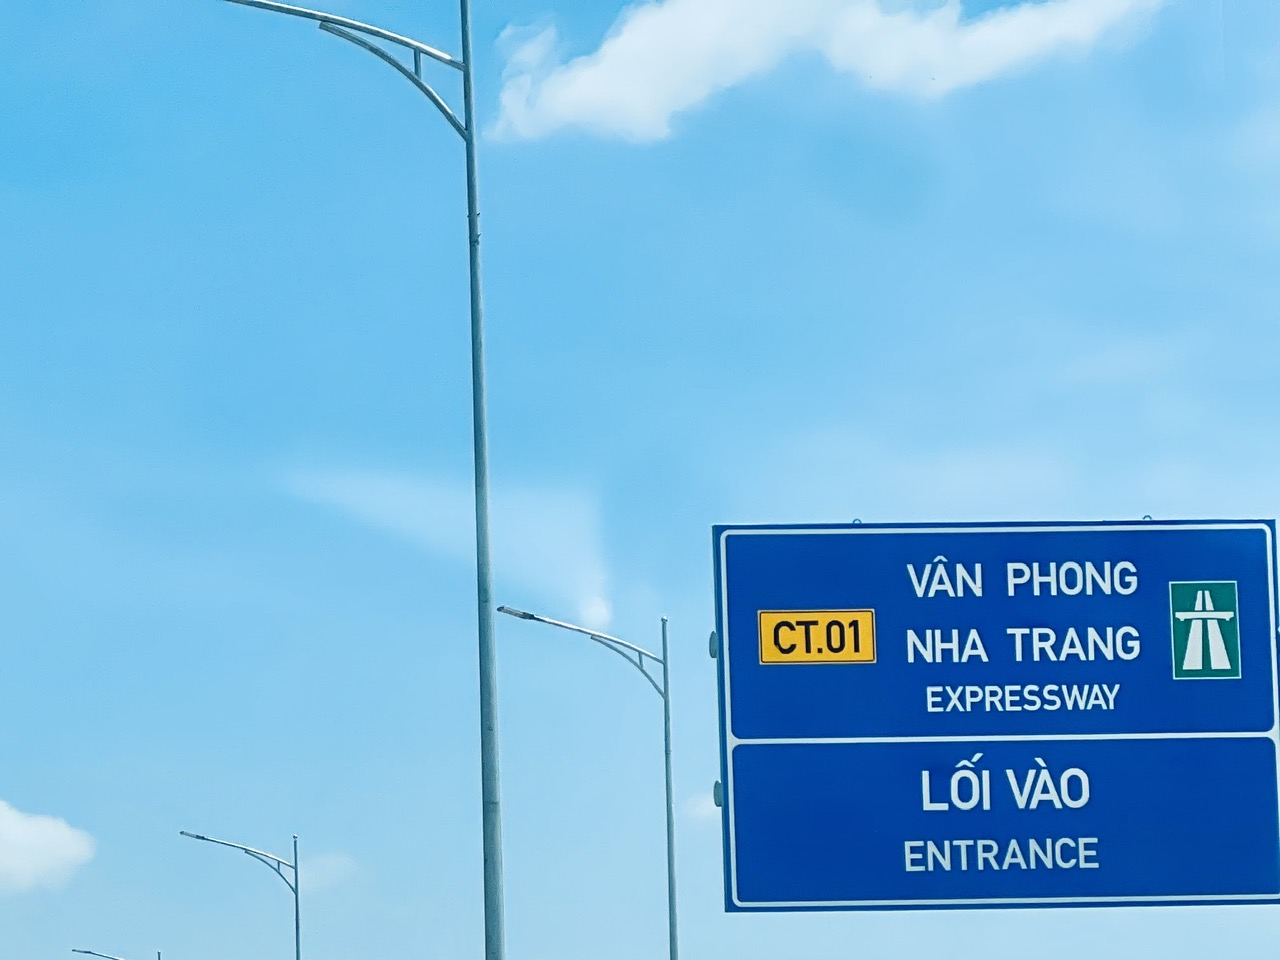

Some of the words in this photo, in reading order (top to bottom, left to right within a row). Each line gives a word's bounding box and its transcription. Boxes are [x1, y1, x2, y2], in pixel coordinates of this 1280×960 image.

[907, 555, 983, 598] VÂN
[1006, 561, 1139, 597] PHONG
[772, 619, 862, 655] CT.01
[906, 629, 990, 664] NHA
[1006, 626, 1141, 662] TRANG
[926, 684, 1121, 713] EXPRESSWAY
[921, 752, 991, 811] LỐI
[1005, 757, 1091, 810] VÀO
[904, 837, 1100, 872] ENTRANCE
